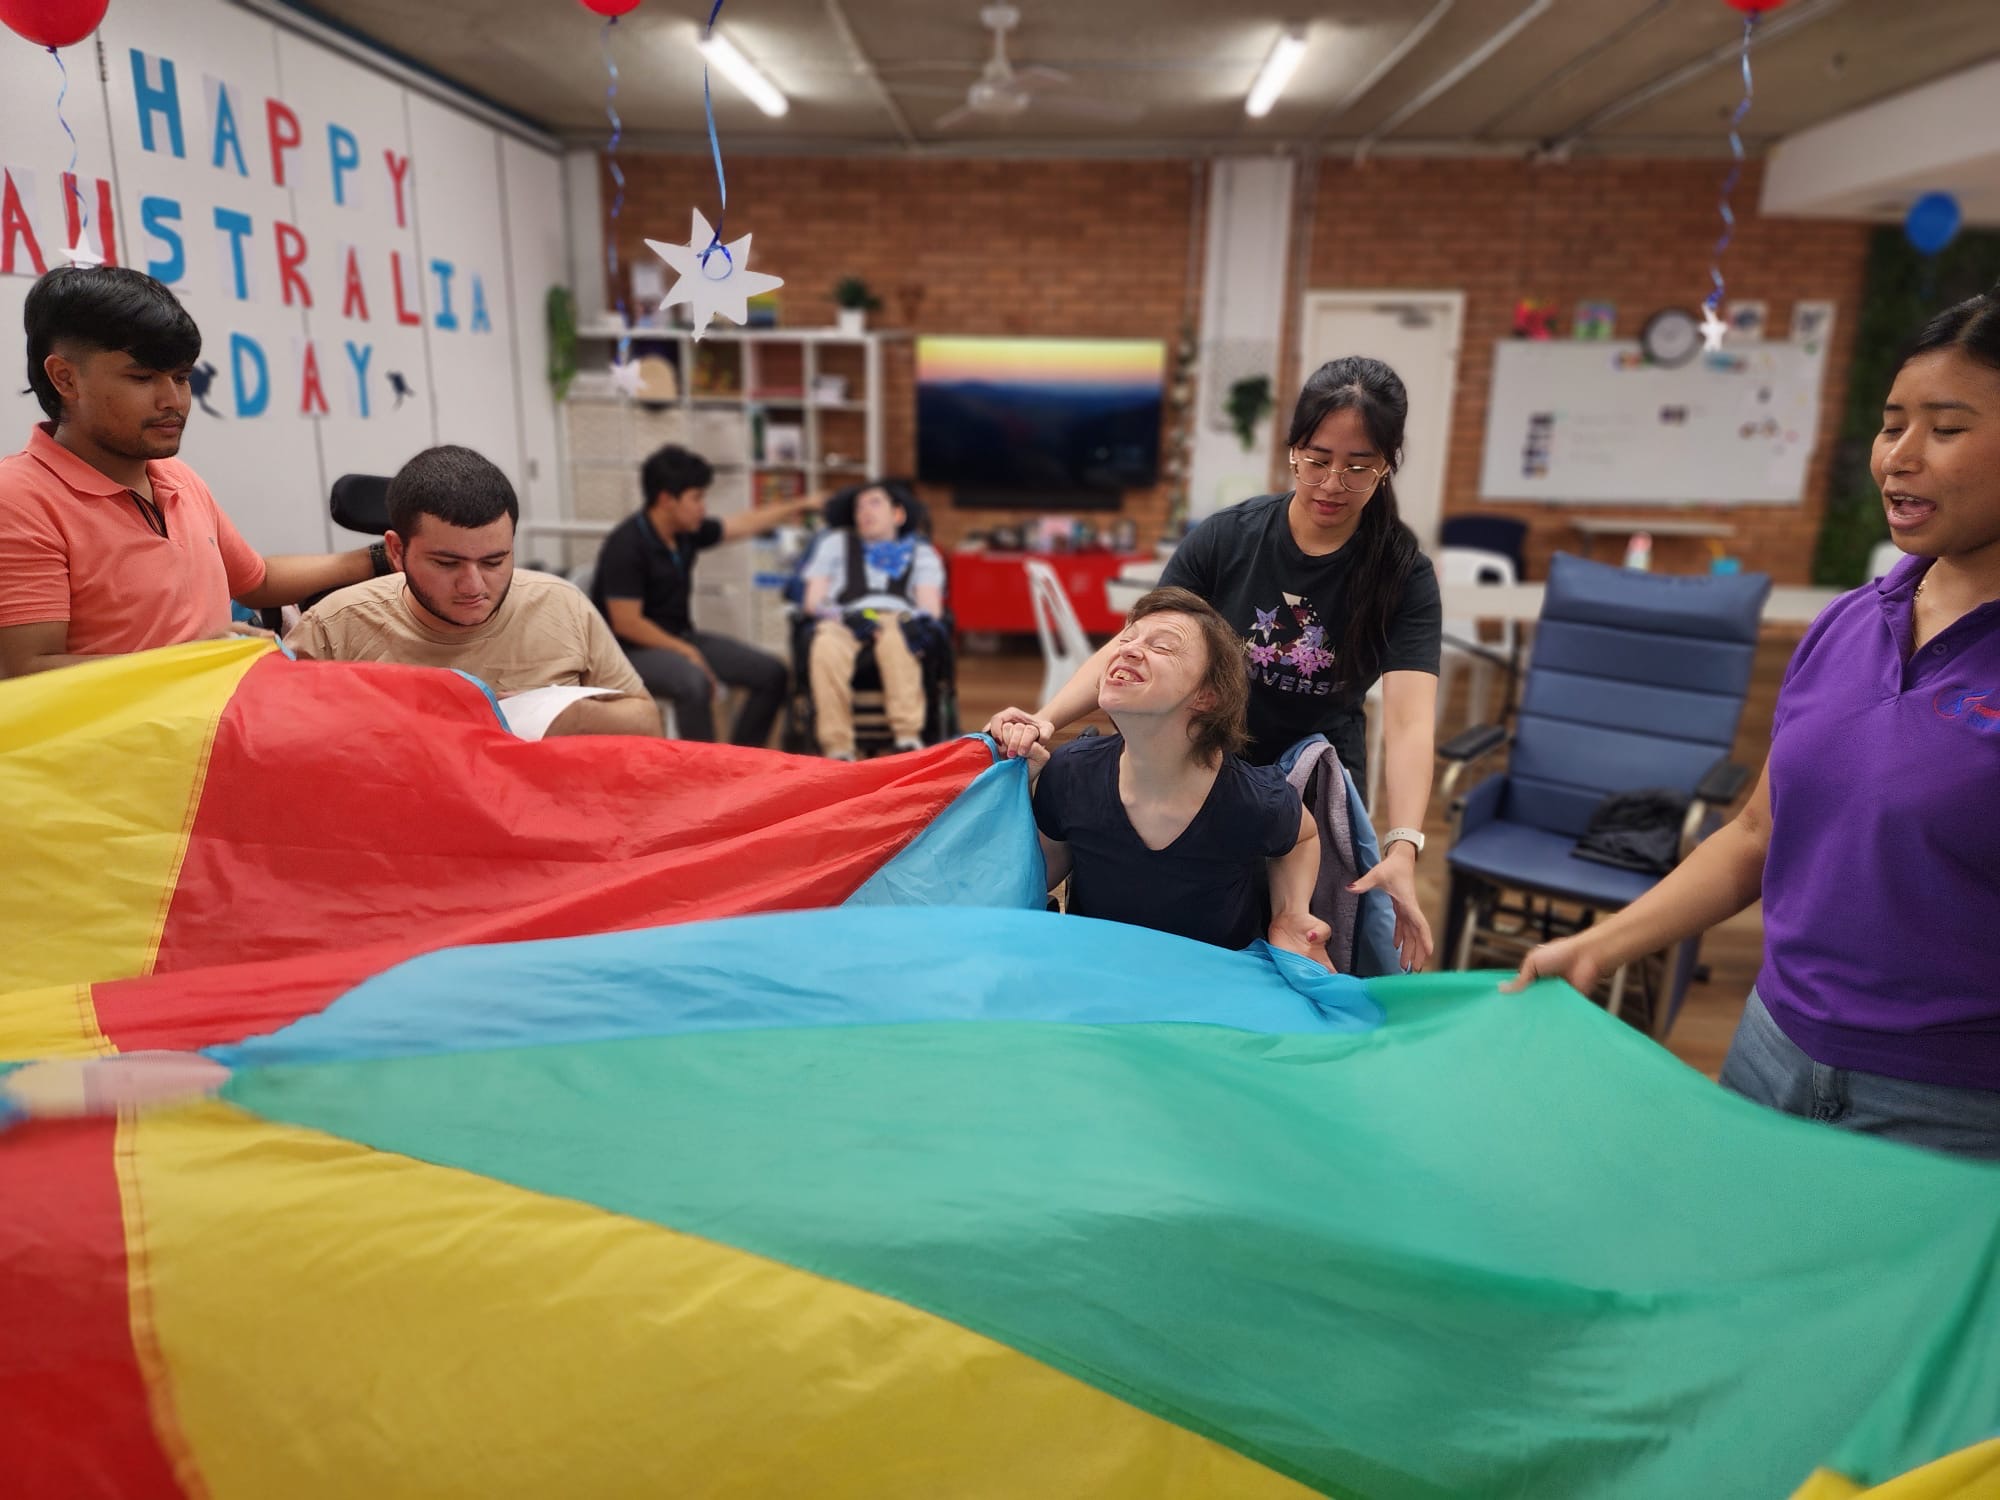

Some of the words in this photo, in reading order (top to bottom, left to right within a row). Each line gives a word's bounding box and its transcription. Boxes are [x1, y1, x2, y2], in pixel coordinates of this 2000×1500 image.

[130, 48, 409, 228] HAPPY
[1, 166, 492, 333] AUSTRALIA
[230, 332, 372, 418] DAY
